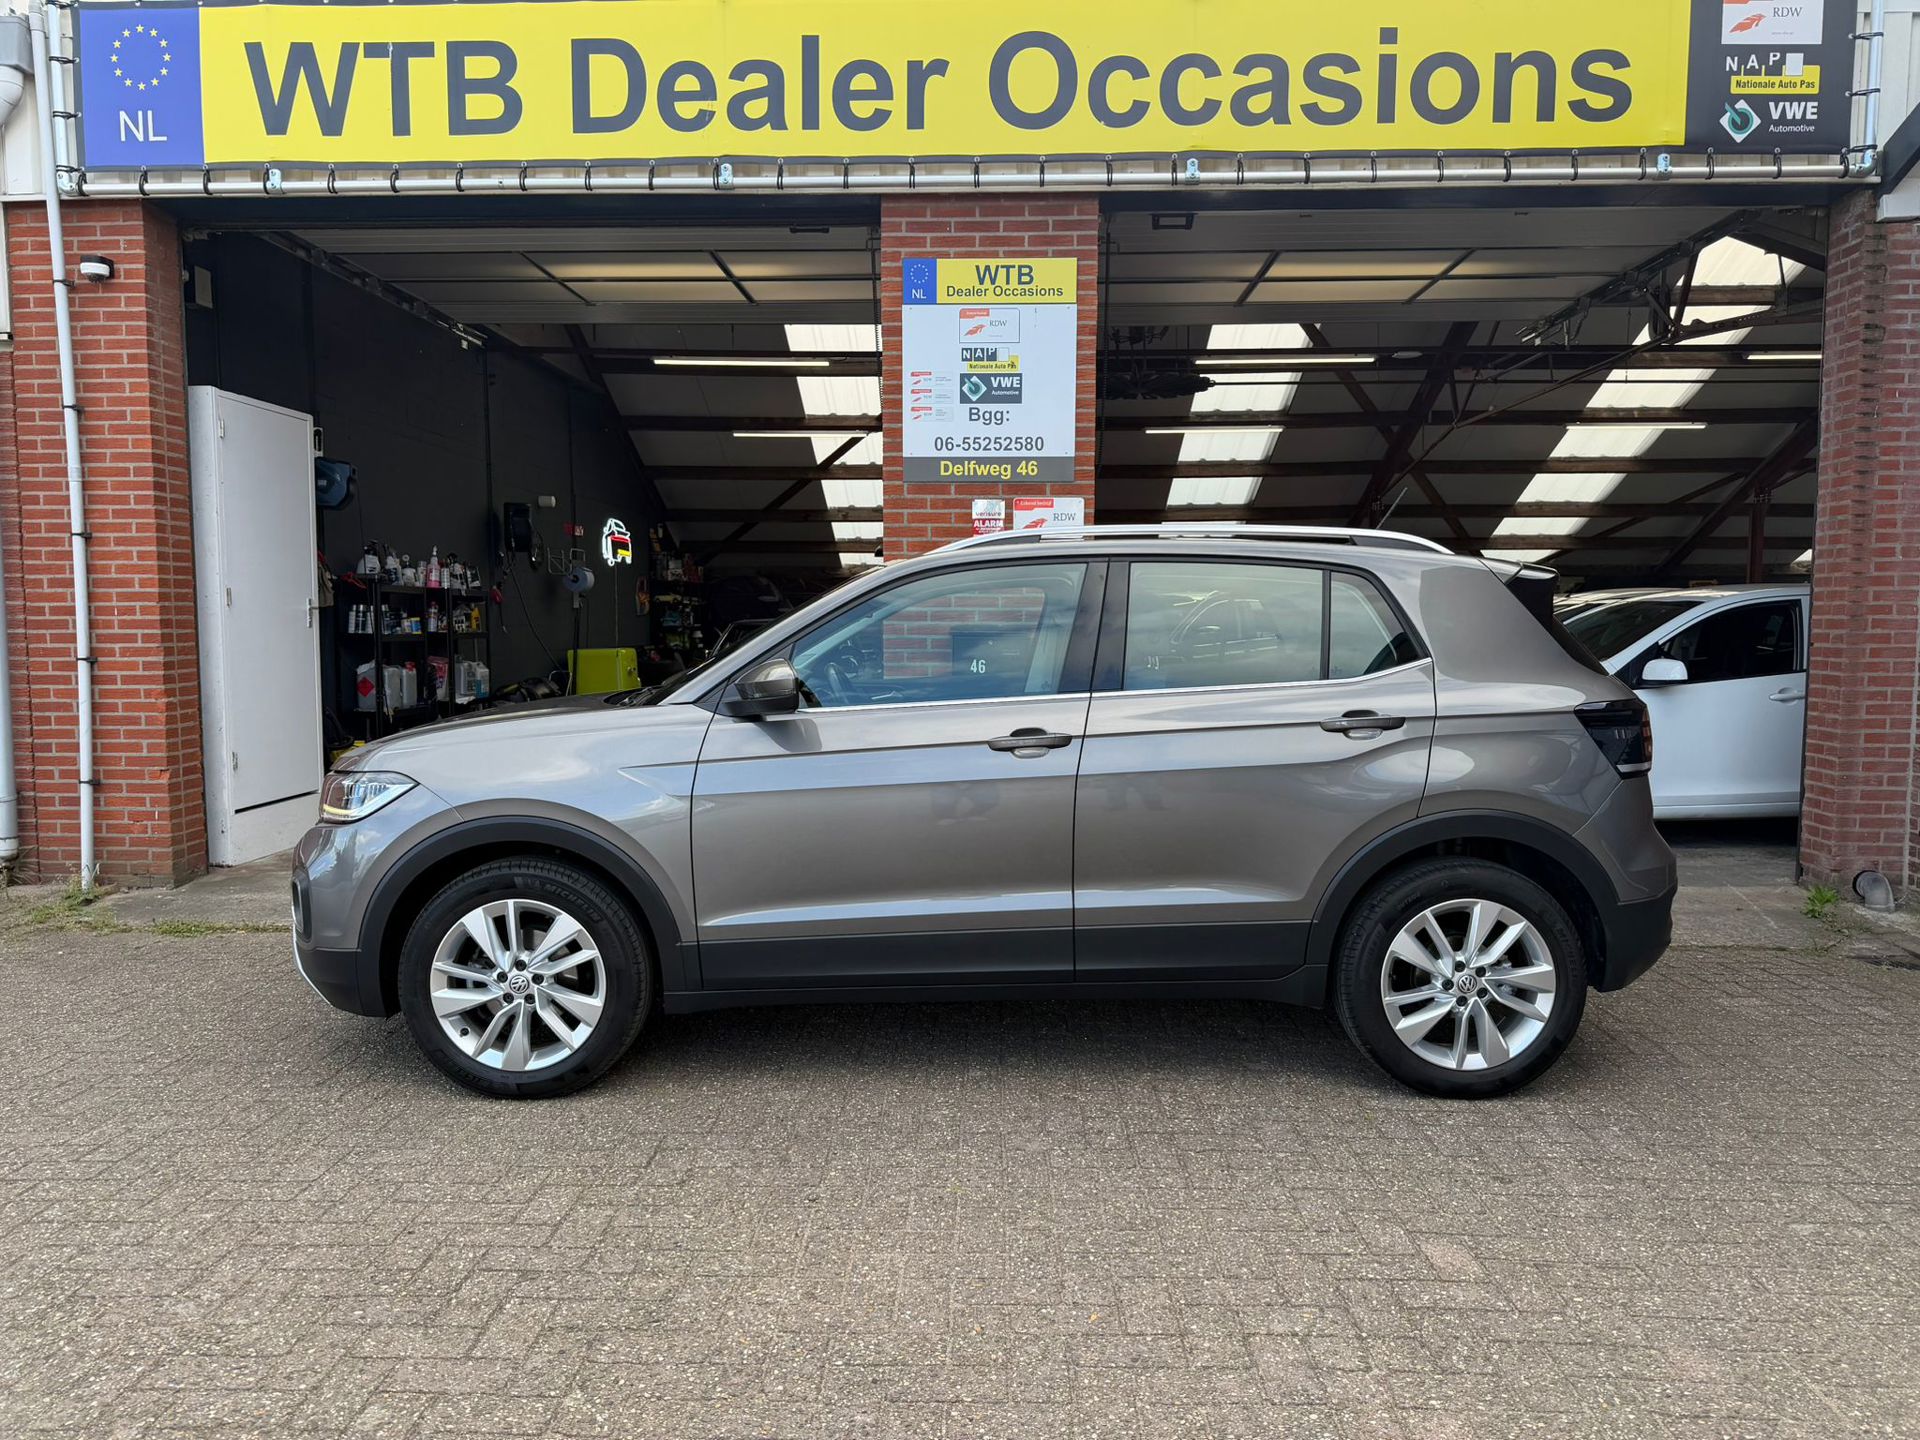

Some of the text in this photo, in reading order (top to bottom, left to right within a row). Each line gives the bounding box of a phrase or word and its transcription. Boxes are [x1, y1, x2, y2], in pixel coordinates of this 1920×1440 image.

[1773, 7, 1802, 17] RDW
[243, 27, 1633, 137] WTB Dealer Occasions
[1735, 79, 1815, 89] Nationale Auto Pas
[1769, 102, 1818, 119] VWE
[118, 110, 168, 142] NL
[1769, 124, 1815, 132] Automotive
[975, 264, 1034, 286] WTB
[912, 288, 927, 299] NL
[947, 285, 1064, 297] Dealer Occasions
[991, 377, 1020, 387] VWE
[969, 407, 1010, 425] Bgg:
[934, 437, 1044, 451] 06-55252580
[940, 460, 1038, 479] Delfweg 46
[1053, 513, 1076, 521] RDW
[974, 520, 1003, 528] ALARM
[970, 659, 986, 674] 46
